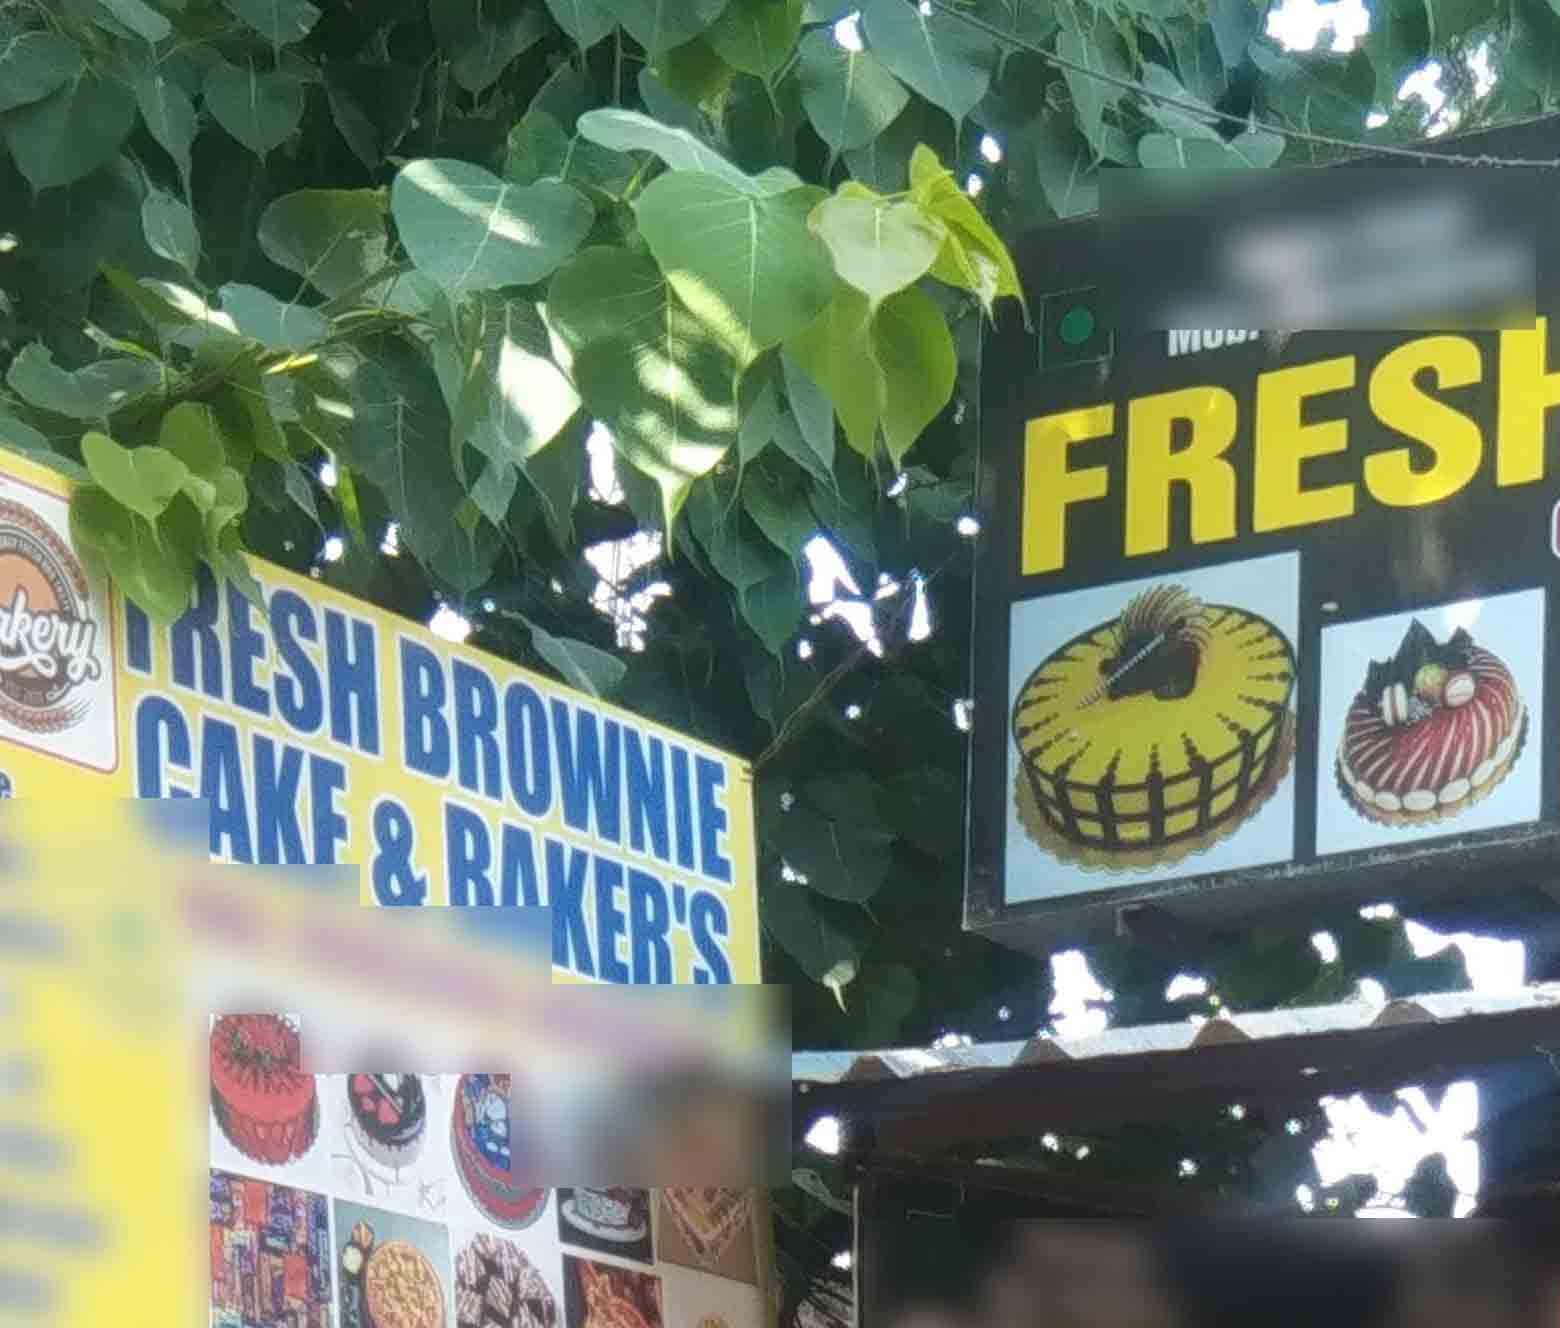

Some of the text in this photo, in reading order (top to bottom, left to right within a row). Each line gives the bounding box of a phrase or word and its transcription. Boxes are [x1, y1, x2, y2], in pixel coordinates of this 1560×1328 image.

[136, 695, 348, 864] CAKE
[372, 800, 427, 906] &
[444, 802, 733, 984] BAKER'S
[399, 637, 733, 883] BROWNIE
